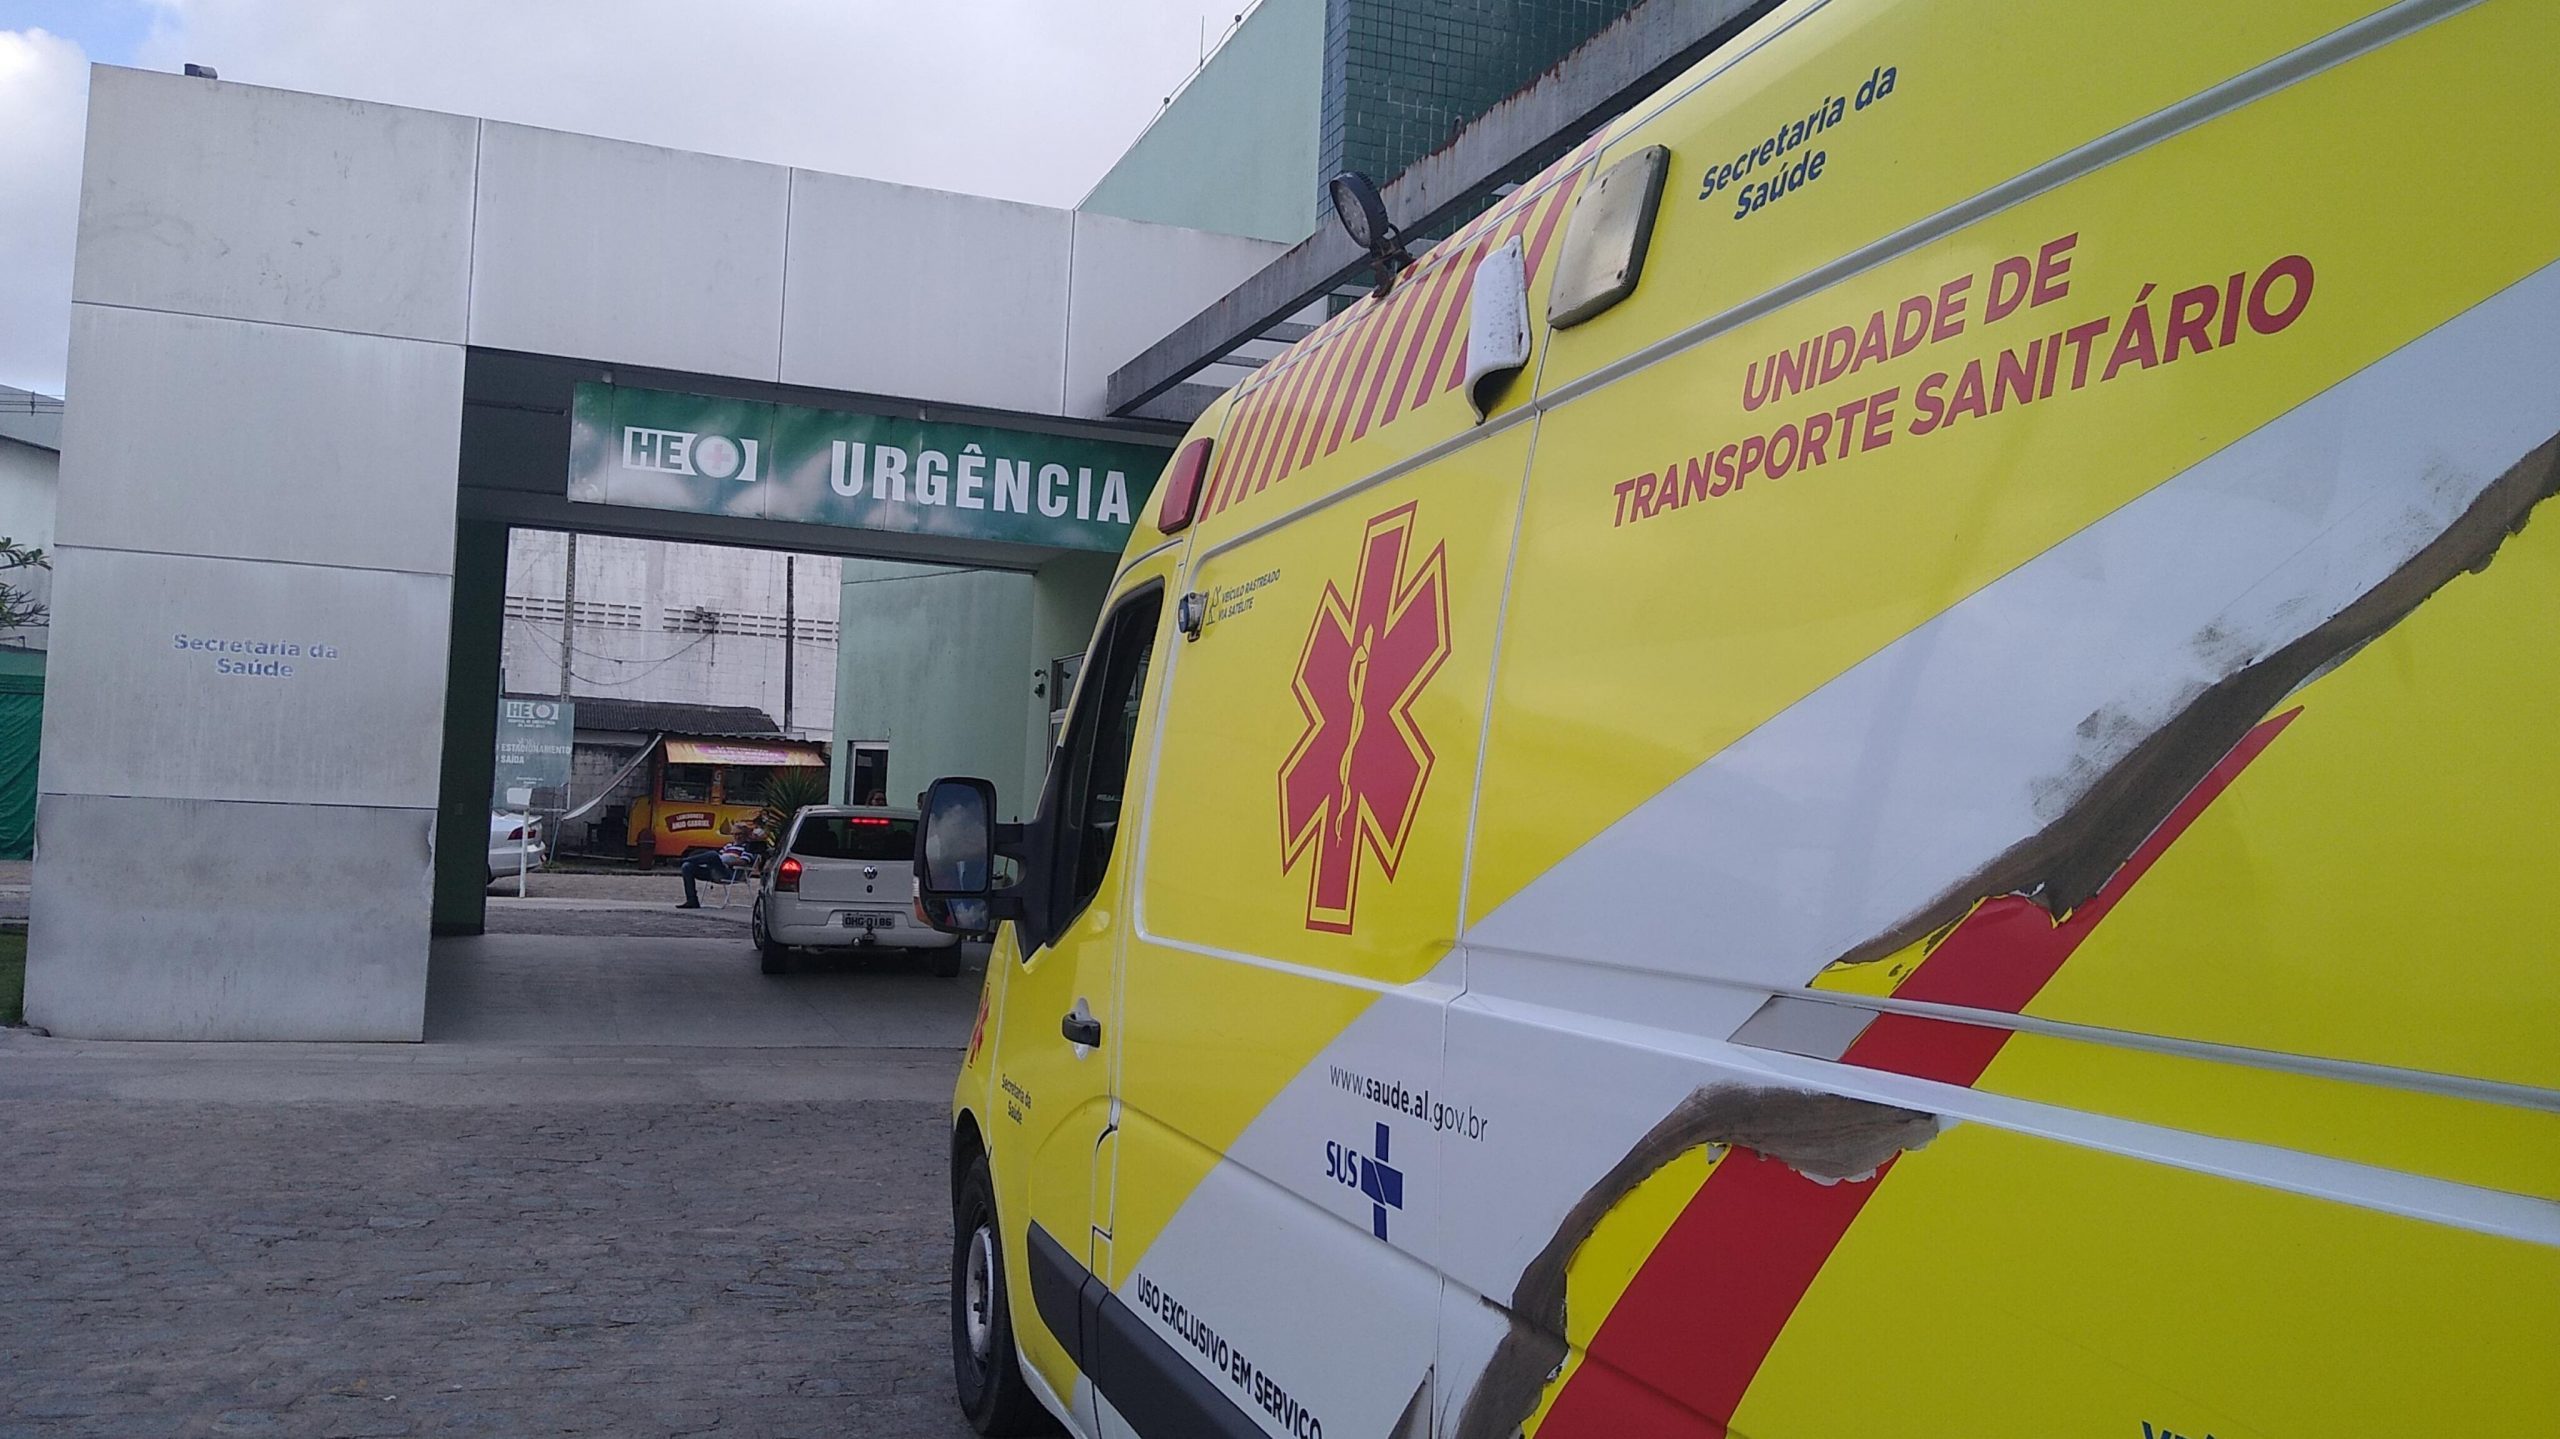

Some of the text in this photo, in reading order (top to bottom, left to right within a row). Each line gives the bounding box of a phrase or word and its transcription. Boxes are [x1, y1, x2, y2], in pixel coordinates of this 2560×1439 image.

[1699, 66, 1897, 200] Secretaria da
[1734, 150, 1826, 220] Saúde
[1742, 232, 2078, 411] UNIDADE DE
[1612, 254, 2315, 527] TRANSPORTE SANITÁRIO
[830, 440, 1131, 525] URGÊNCIA
[1245, 568, 1281, 594] RASTREADO
[173, 633, 338, 659] Secretaria da
[217, 657, 294, 677] Saúde
[501, 743, 571, 754] ESTACIONAMENTO
[1002, 1073, 1032, 1110] Secretaria da
[1008, 1100, 1022, 1126] Saúde
[1329, 1064, 1488, 1142] www.saude.al.gov.br
[1326, 1140, 1358, 1188] SUS
[1138, 1273, 1160, 1314] USO
[1162, 1292, 1229, 1372] EXCLUSIVO
[1231, 1349, 1252, 1395] EM
